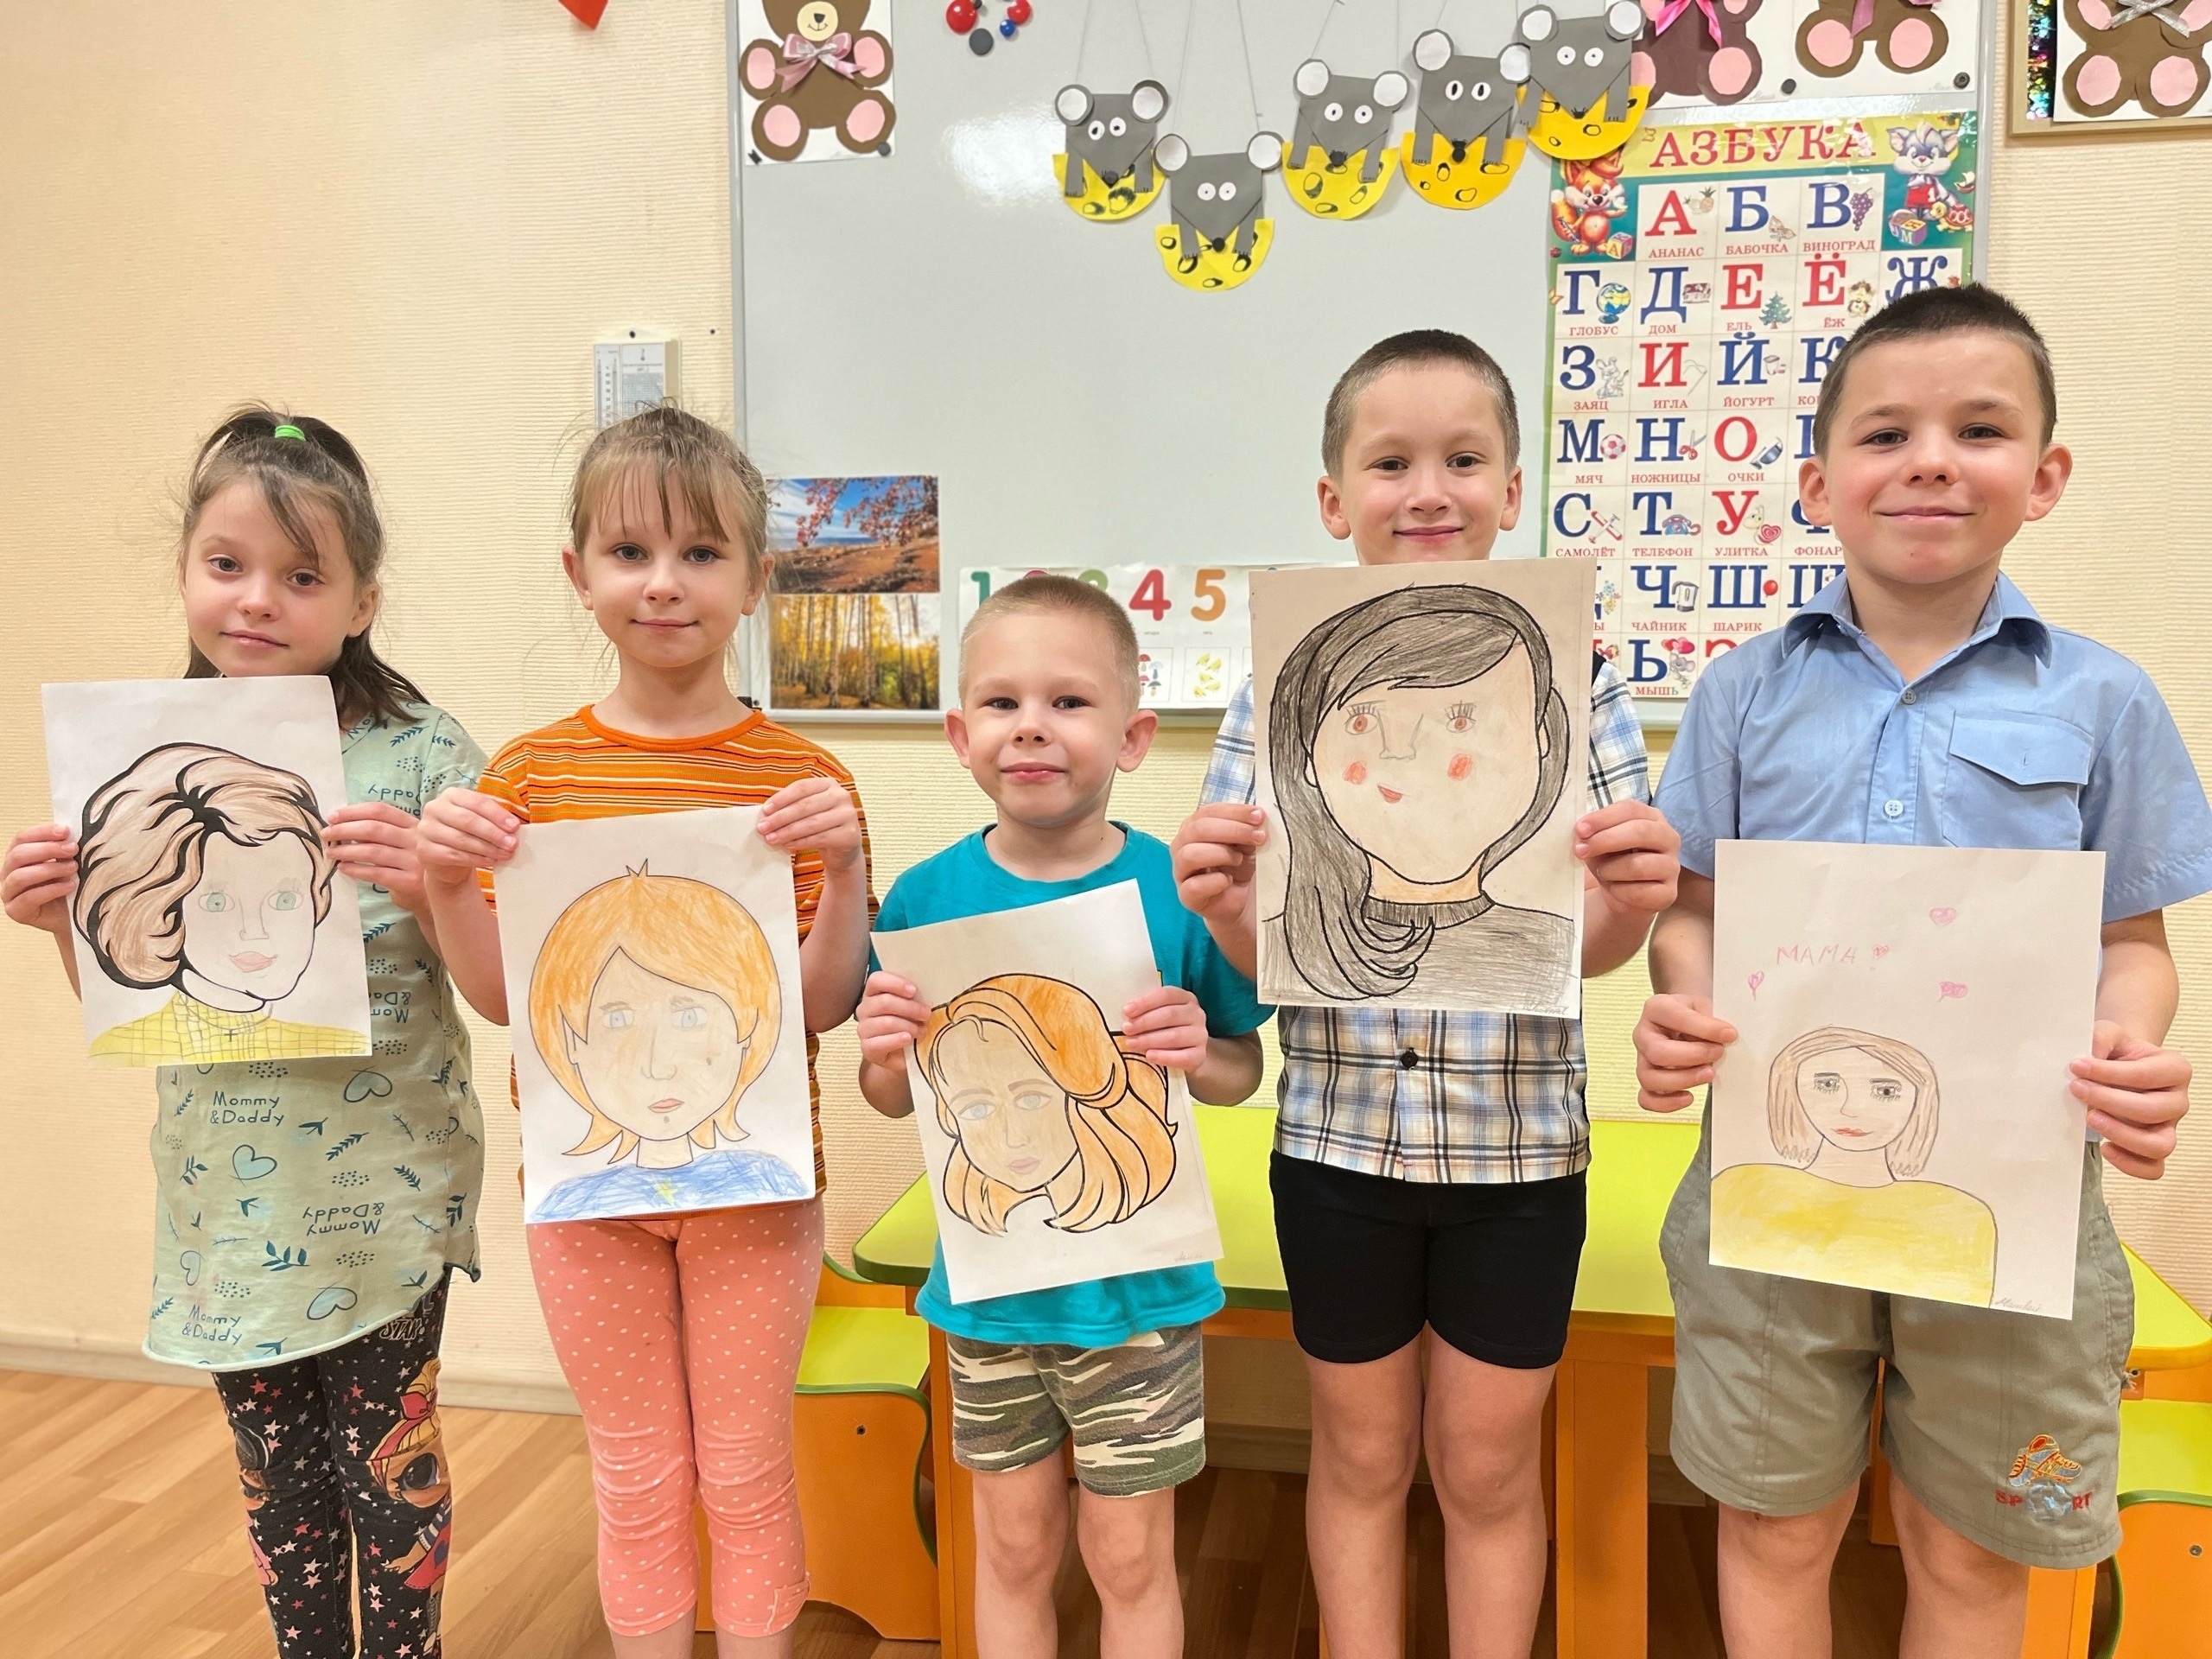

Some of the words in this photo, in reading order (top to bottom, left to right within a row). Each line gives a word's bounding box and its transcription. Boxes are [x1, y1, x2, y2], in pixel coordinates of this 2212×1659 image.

[1649, 122, 1877, 168] АЗБУКА
[1644, 190, 1697, 237] А
[1725, 185, 1770, 233] Б
[1807, 182, 1852, 229] В
[1649, 247, 1704, 258] АНАНАС
[1726, 243, 1789, 256] БАБОЧКА
[1803, 240, 1875, 252] ВИНОГРАД
[1720, 264, 1764, 310] Е
[1802, 252, 1846, 307] Ё
[1885, 255, 1948, 303] Ж
[1563, 270, 1600, 315] Г
[1641, 266, 1689, 325] Д
[1569, 324, 1618, 337] ГЛОБУС
[1649, 323, 1676, 336] ДОМ
[1726, 321, 1752, 332] ЕЛЬ
[1823, 317, 1846, 328] ЁЖ
[1560, 344, 1596, 391] З
[1637, 342, 1690, 388] И
[1717, 332, 1770, 386] Й
[1798, 336, 1847, 383] К
[1573, 401, 1609, 411] ЗАЯЦ
[1653, 399, 1688, 410] ИГЛА
[1723, 396, 1774, 408] ЙОГУРТ
[1797, 396, 1821, 405] КО
[1556, 419, 1605, 463] М
[1634, 417, 1686, 462] Н
[1713, 416, 1758, 462] О
[1575, 474, 1603, 485] МЯЧ
[1630, 474, 1700, 485] НОЖНИЦЫ
[1728, 473, 1764, 483] ОЧКИ
[1554, 493, 1592, 538] С
[1632, 492, 1672, 537] Т
[1712, 490, 1759, 537] У
[1555, 546, 1615, 557] САМОЛЁТ
[1632, 547, 1693, 557] ТЕЛЕФОН
[1714, 546, 1768, 556] УЛИТКА
[1794, 546, 1842, 556] ФОНАР
[1128, 569, 1172, 621] 4
[1191, 569, 1226, 621] 5
[1630, 565, 1677, 609] Ч
[1707, 564, 1768, 609] Ш
[1631, 620, 1687, 632] ЧАЙНИК
[1713, 621, 1762, 632] ШАРИК
[1626, 639, 1668, 683] Ь
[1635, 686, 1679, 696] МЫШЬ
[1777, 944, 1857, 966] МАМА
[213, 1090, 280, 1109] Mommy
[209, 1109, 285, 1127] &Daddy
[306, 1218, 380, 1236] Mommy
[188, 1304, 242, 1327] Mommy
